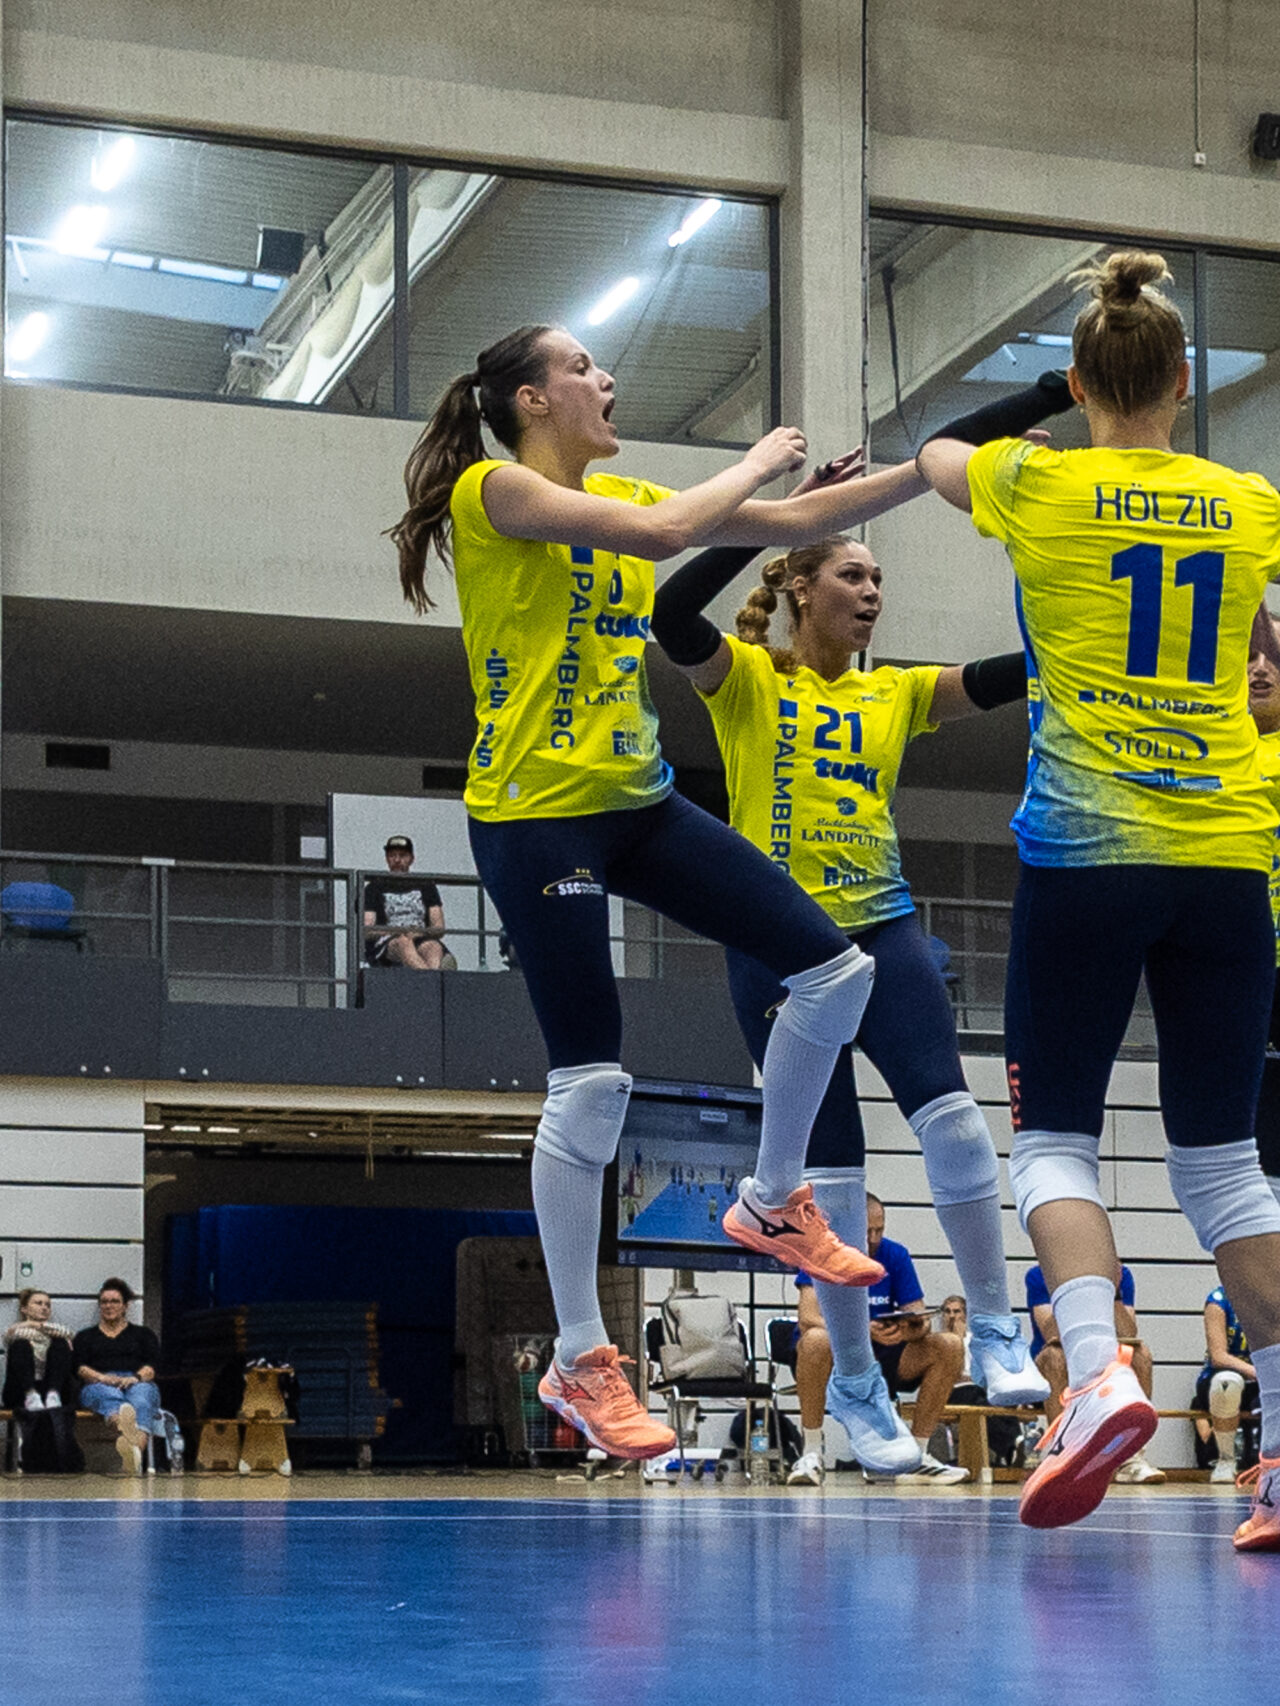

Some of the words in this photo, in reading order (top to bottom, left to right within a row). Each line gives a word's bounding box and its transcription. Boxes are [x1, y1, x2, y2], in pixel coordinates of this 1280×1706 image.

[1095, 483, 1233, 530] HÖLZIG
[1110, 542, 1225, 685] 11
[550, 571, 595, 749] PALMBERG
[813, 704, 863, 754] 21
[558, 882, 581, 896] SSC
